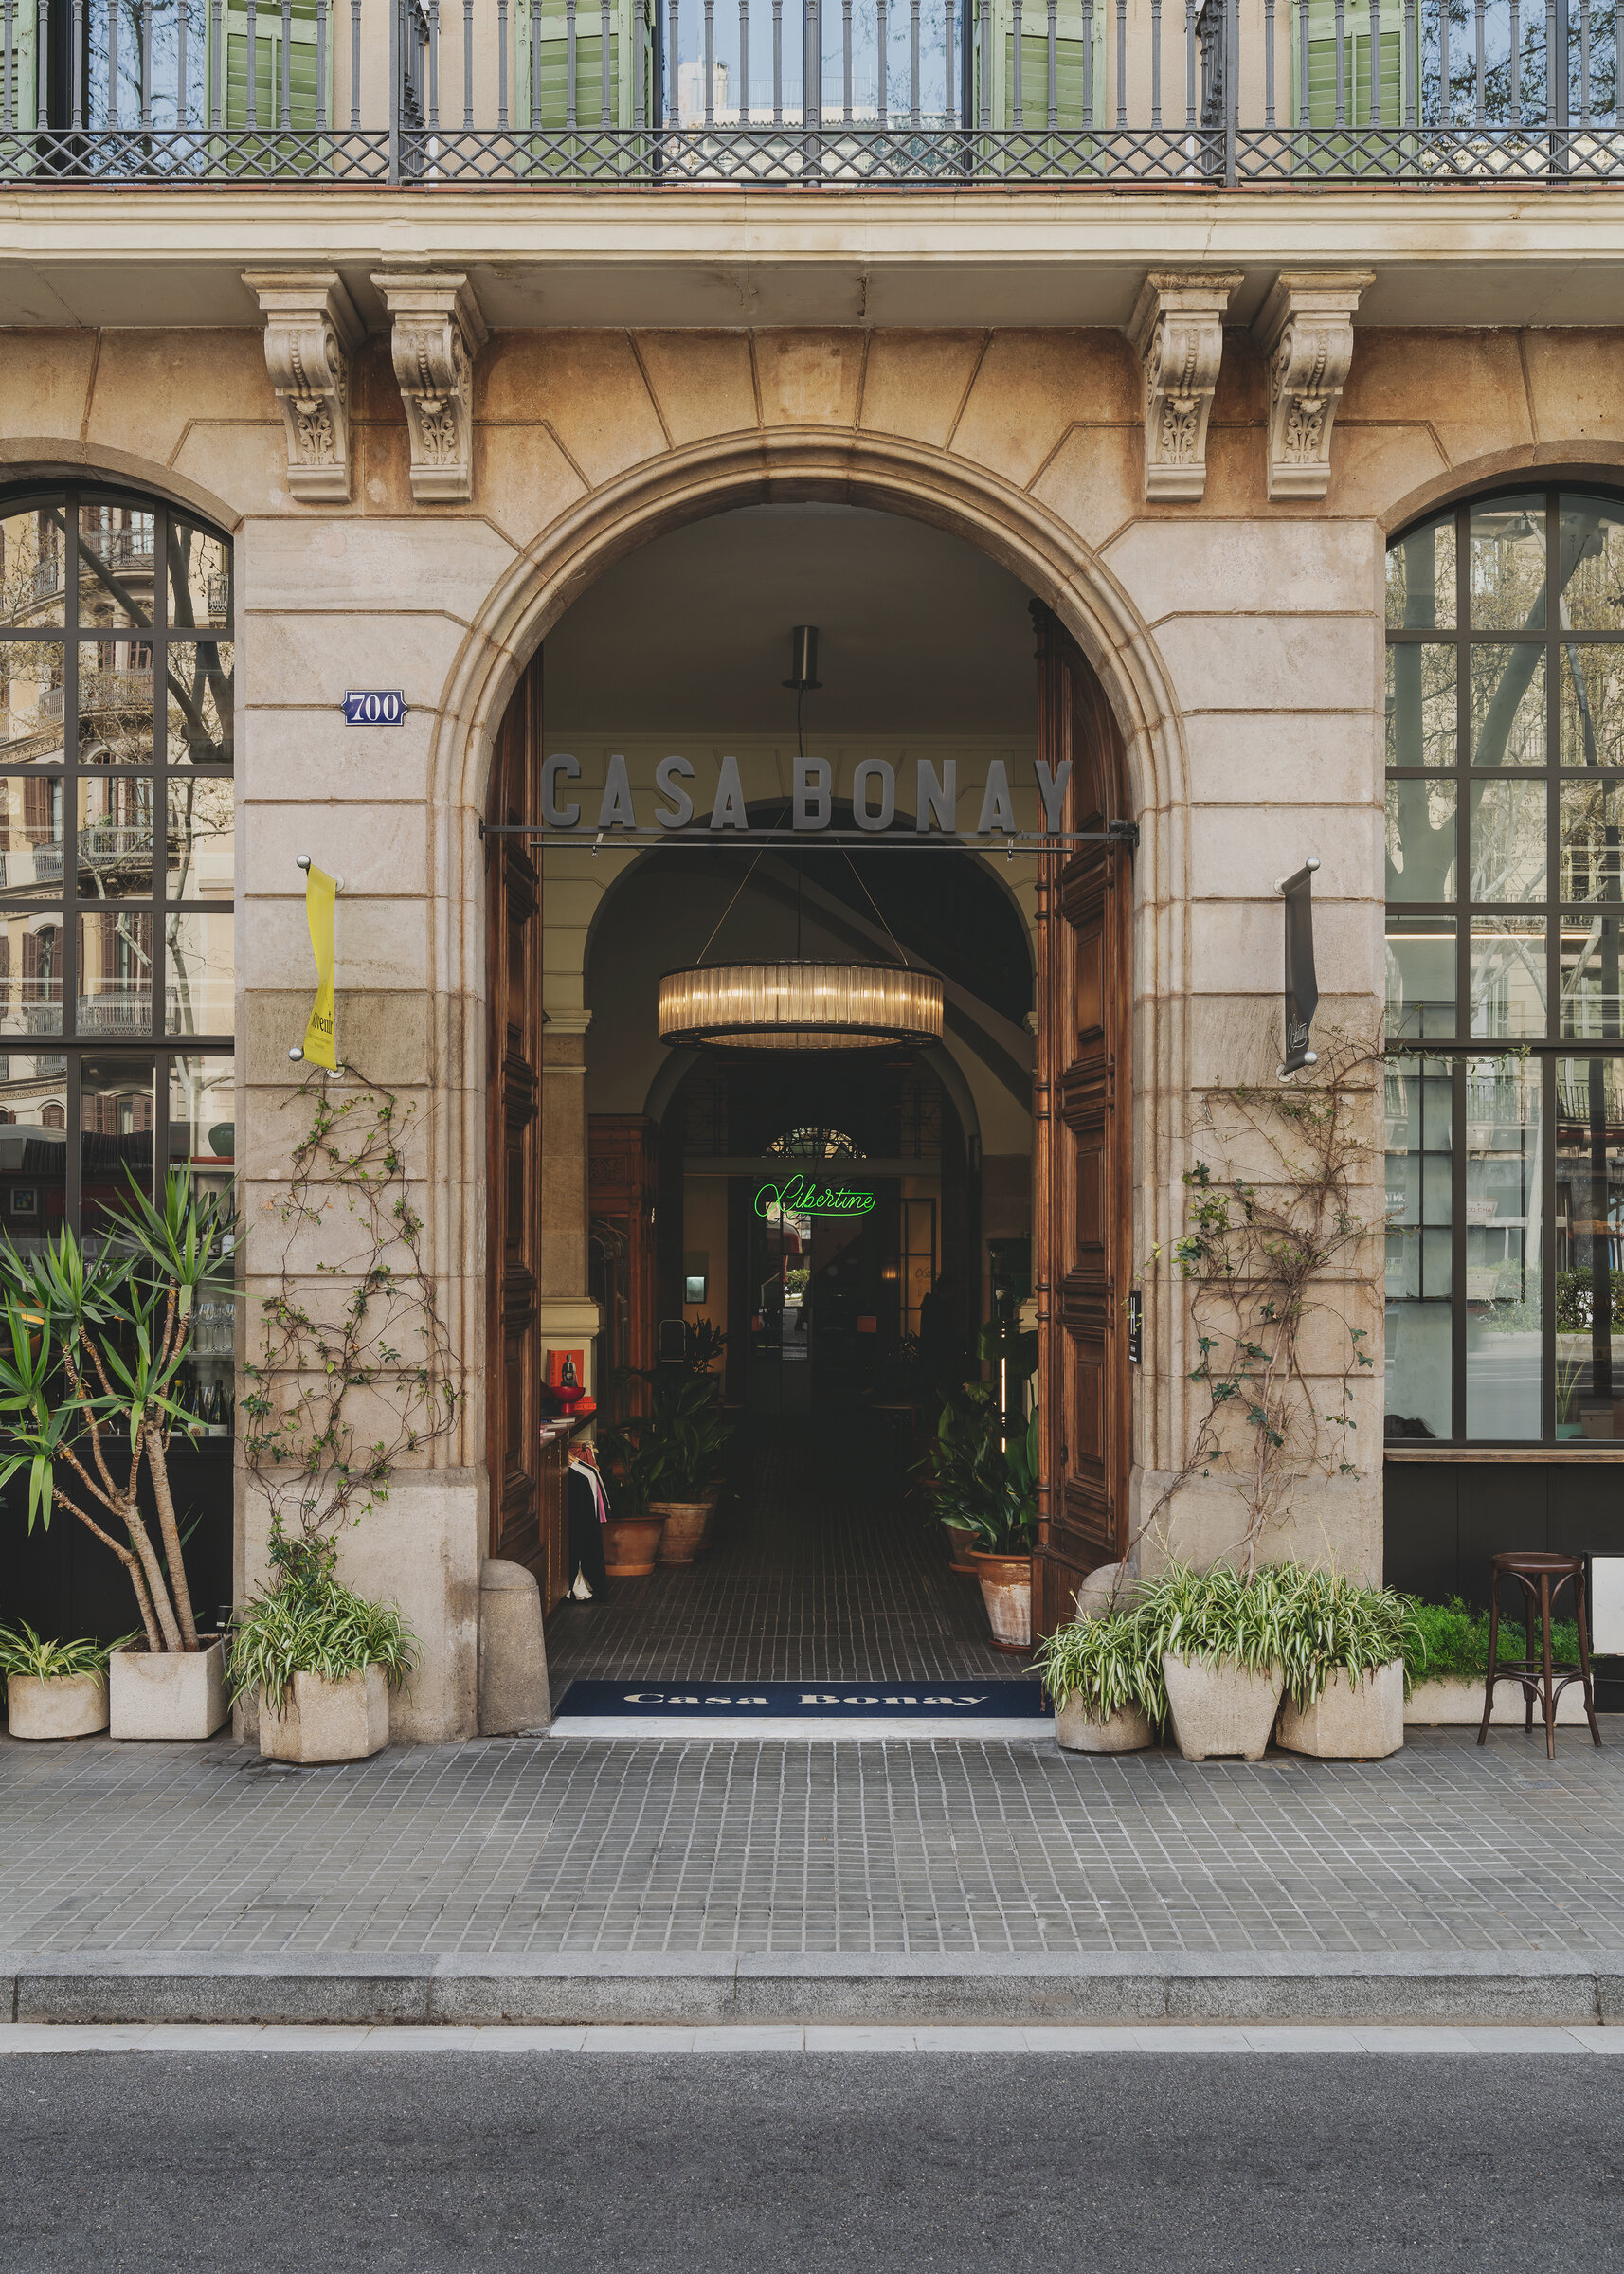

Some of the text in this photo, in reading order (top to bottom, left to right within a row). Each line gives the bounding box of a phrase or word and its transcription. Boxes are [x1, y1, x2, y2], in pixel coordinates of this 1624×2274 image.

[349, 694, 399, 721] 700
[540, 754, 1074, 833] CASA BONAY
[754, 1174, 875, 1218] Libertine
[623, 1693, 990, 1706] Casa Bonay
